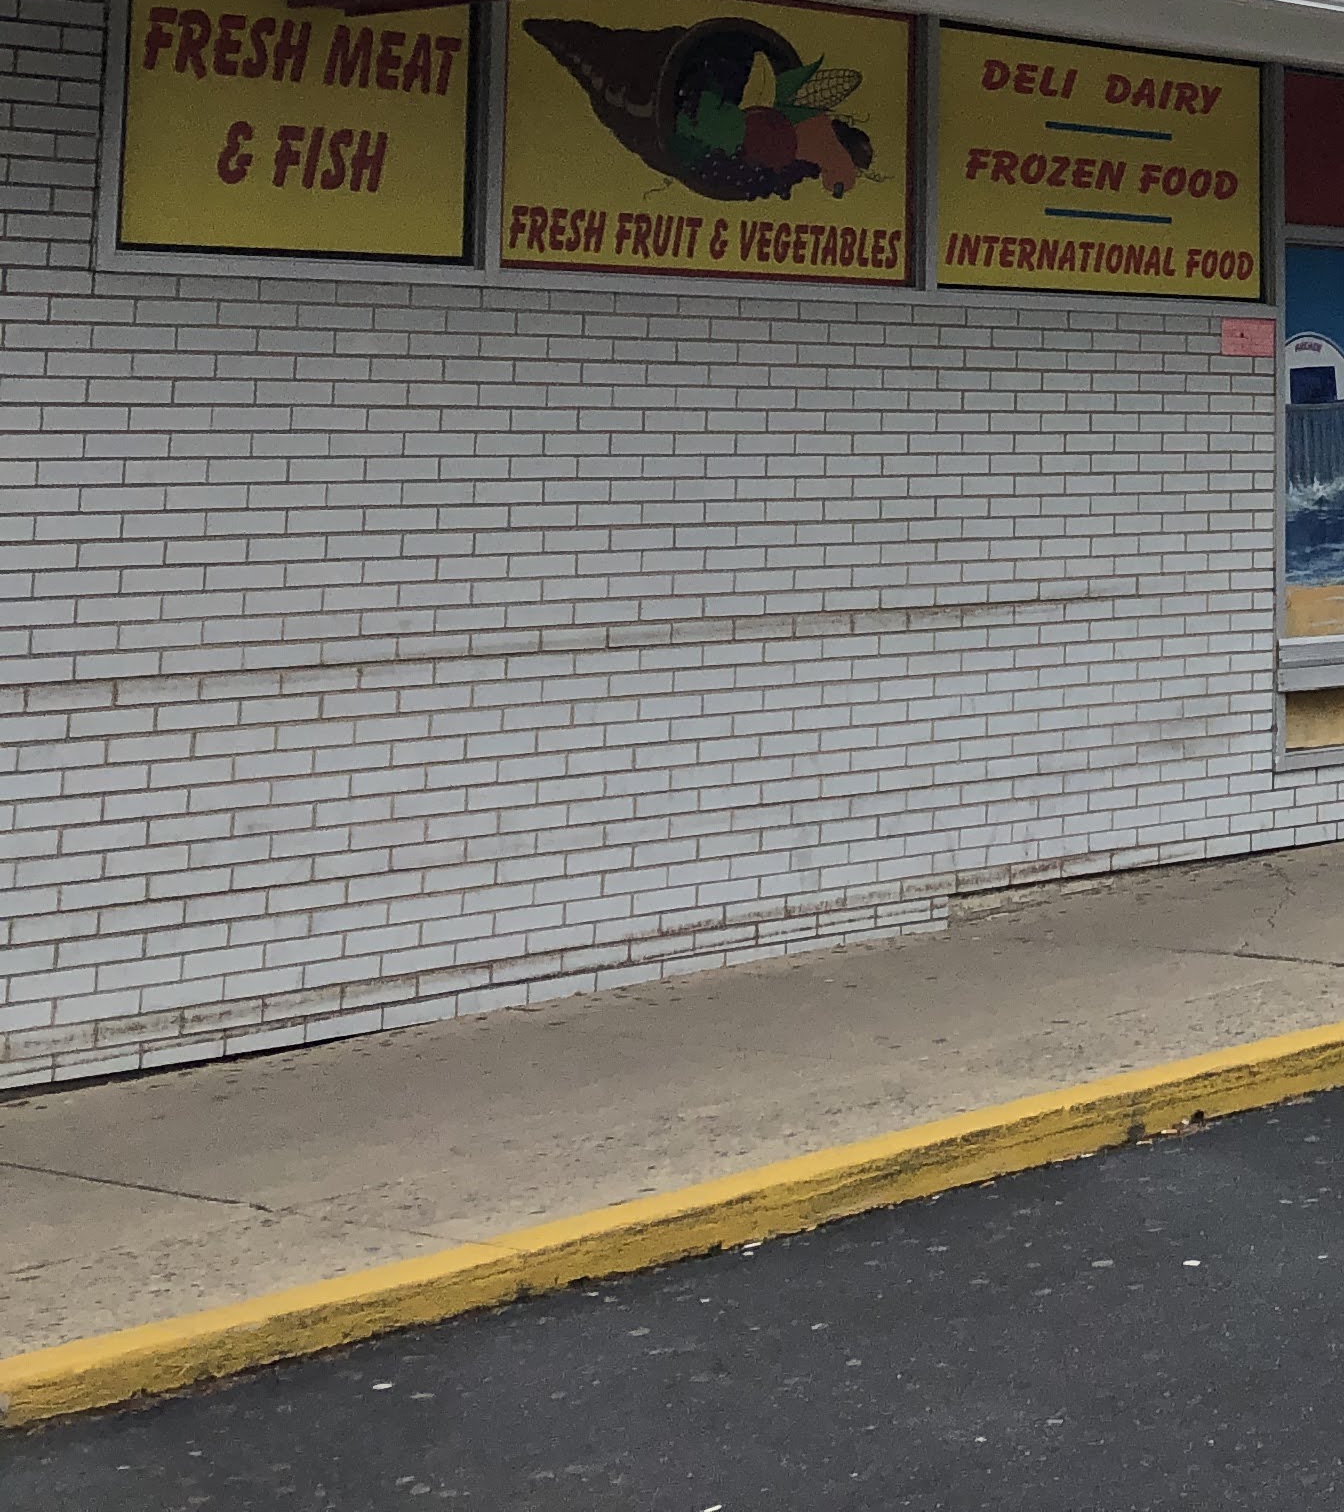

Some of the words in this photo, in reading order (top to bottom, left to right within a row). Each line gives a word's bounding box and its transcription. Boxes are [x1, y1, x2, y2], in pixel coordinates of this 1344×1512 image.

[144, 7, 311, 82] FRESH
[323, 25, 462, 96] MEAT
[981, 59, 1078, 99] DELI
[1105, 73, 1222, 115] DAIRY
[217, 120, 253, 185] &
[273, 125, 389, 192] FISH
[965, 148, 1127, 192] FROZEN
[1138, 163, 1239, 200] FOOD
[508, 205, 606, 253] FRESH
[615, 212, 703, 259] FRUIT
[709, 218, 729, 260] &
[739, 220, 902, 269] VEGETABLES
[945, 233, 1176, 277] INTERNATIONAL
[1185, 248, 1254, 280] FOOD
